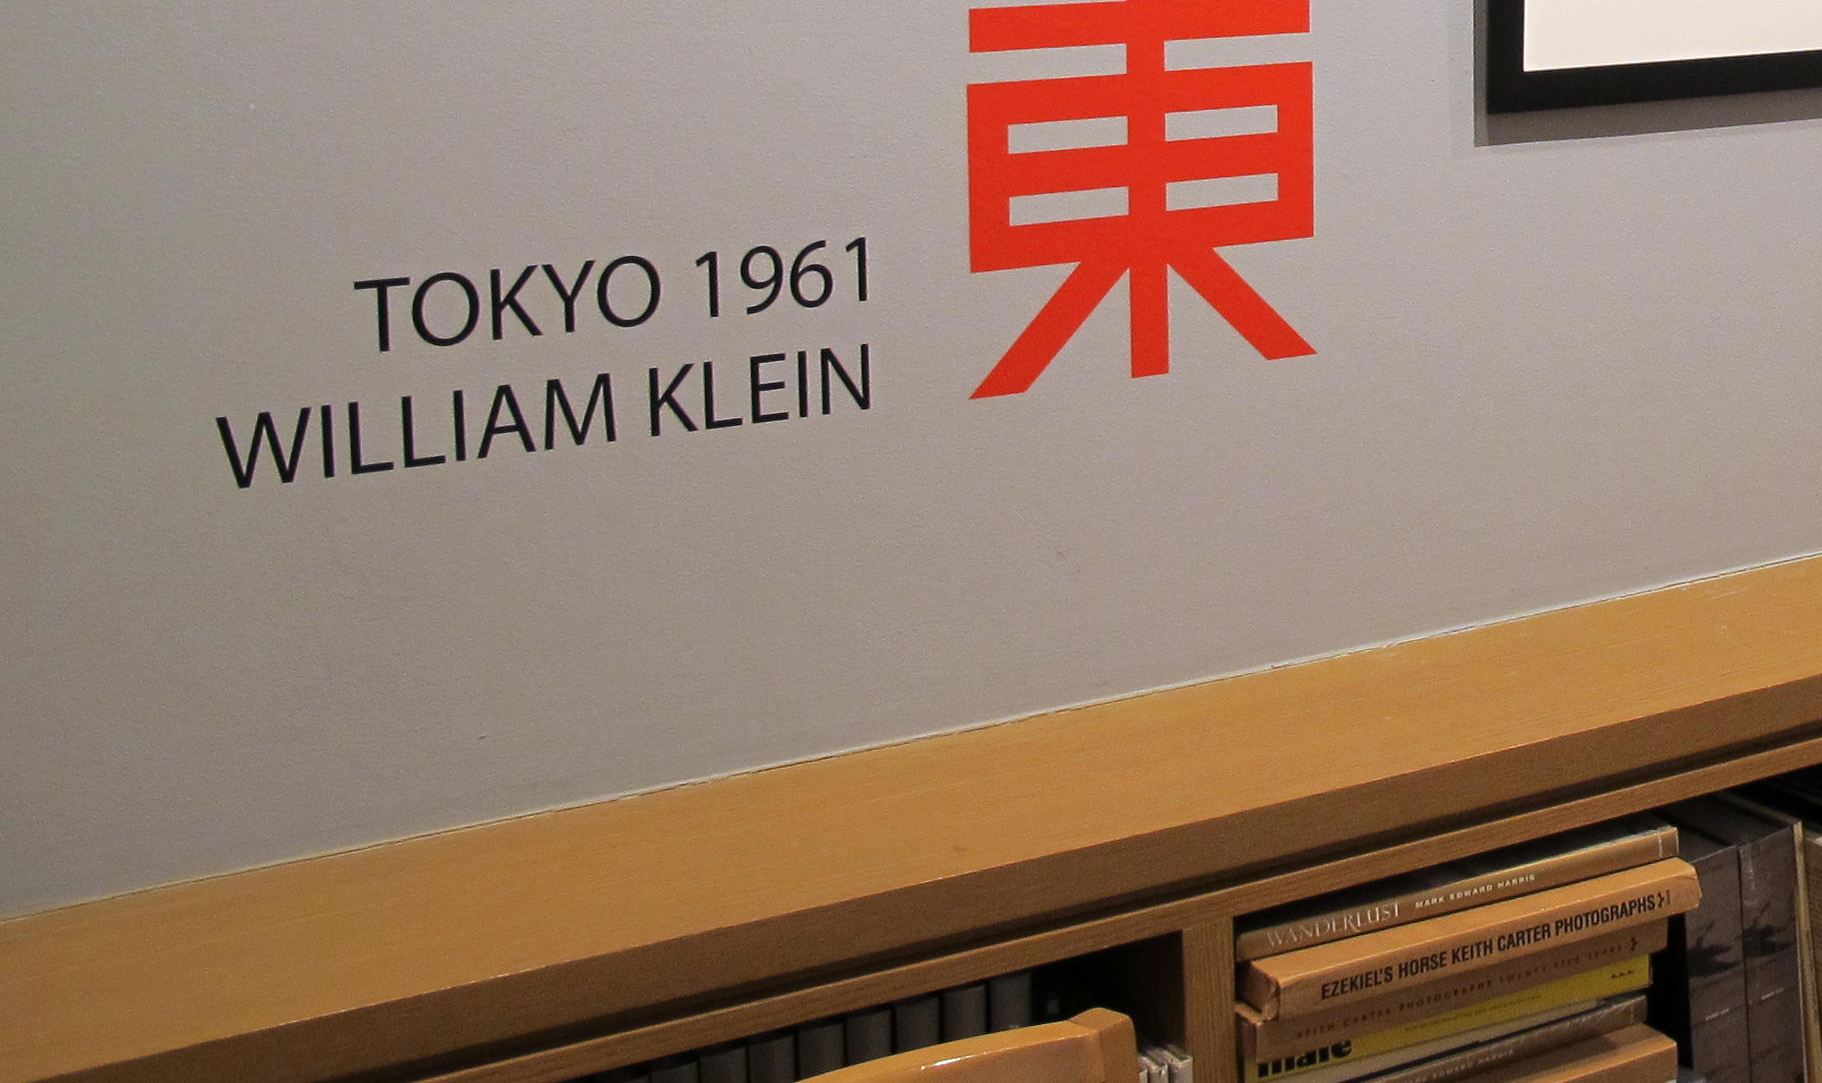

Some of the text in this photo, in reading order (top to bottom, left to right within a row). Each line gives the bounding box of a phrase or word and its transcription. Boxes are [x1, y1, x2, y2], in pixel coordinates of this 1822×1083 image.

[353, 236, 868, 352] TOKYO 1961
[216, 343, 871, 489] WILLIAM KLEIN
[1266, 873, 1536, 947] WANDERLUST MARK EDWARD HARRIS
[1321, 894, 1656, 1000] EZEKIEL'S HORSE KEITH CARTER PHOTOGRAPHS
[1400, 979, 1493, 1011] PHOTOGRAPHS
